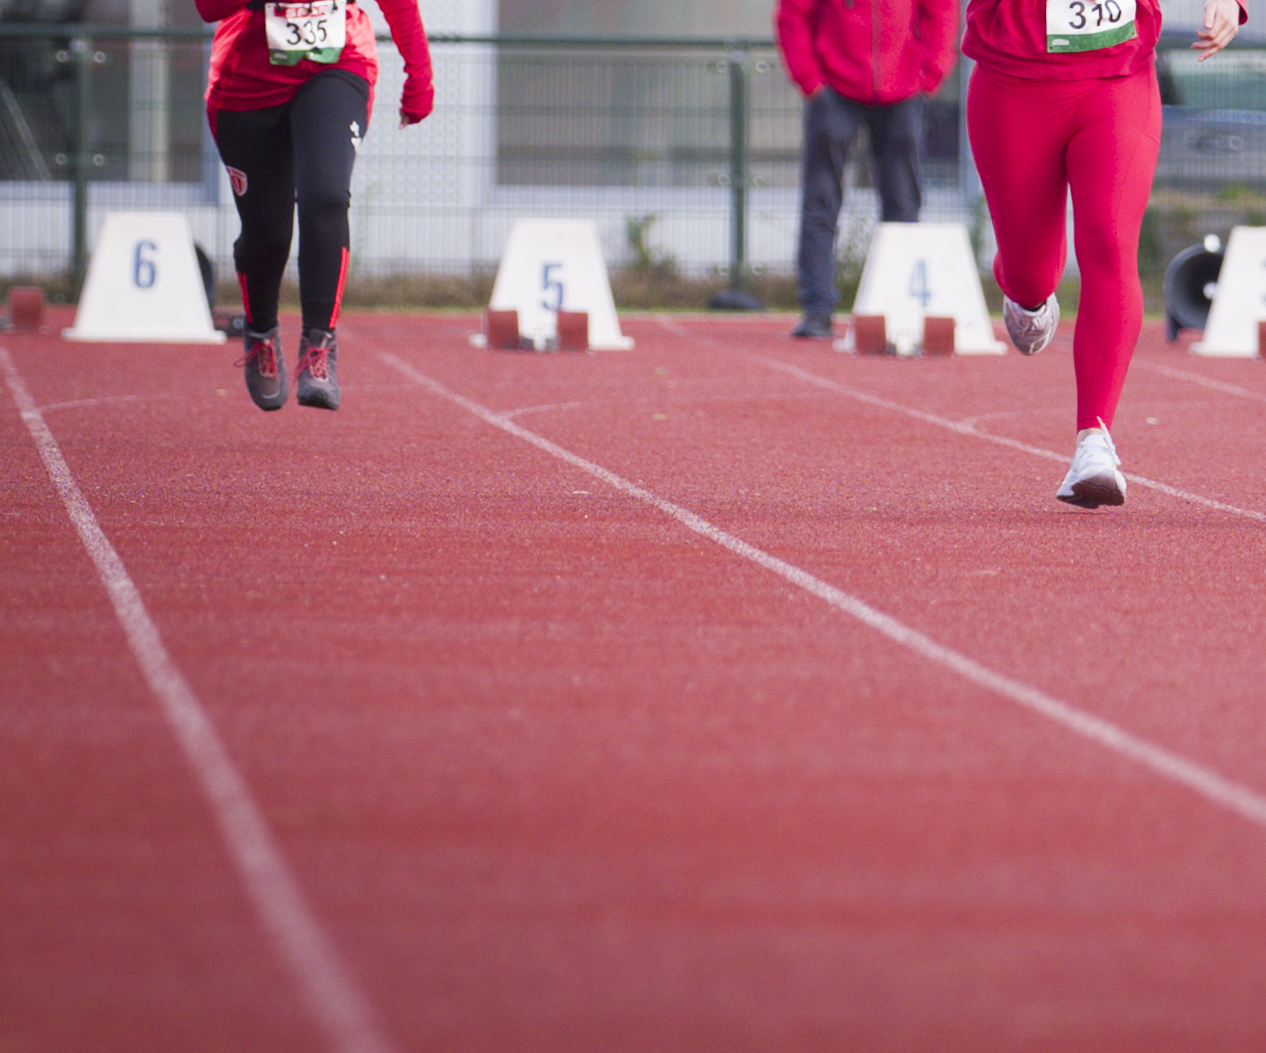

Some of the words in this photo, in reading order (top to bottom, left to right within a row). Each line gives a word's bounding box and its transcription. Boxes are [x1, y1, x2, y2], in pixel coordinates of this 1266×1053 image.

[285, 19, 328, 46] 335
[133, 240, 157, 290] 6
[541, 263, 564, 312] 5
[908, 260, 932, 308] 4
